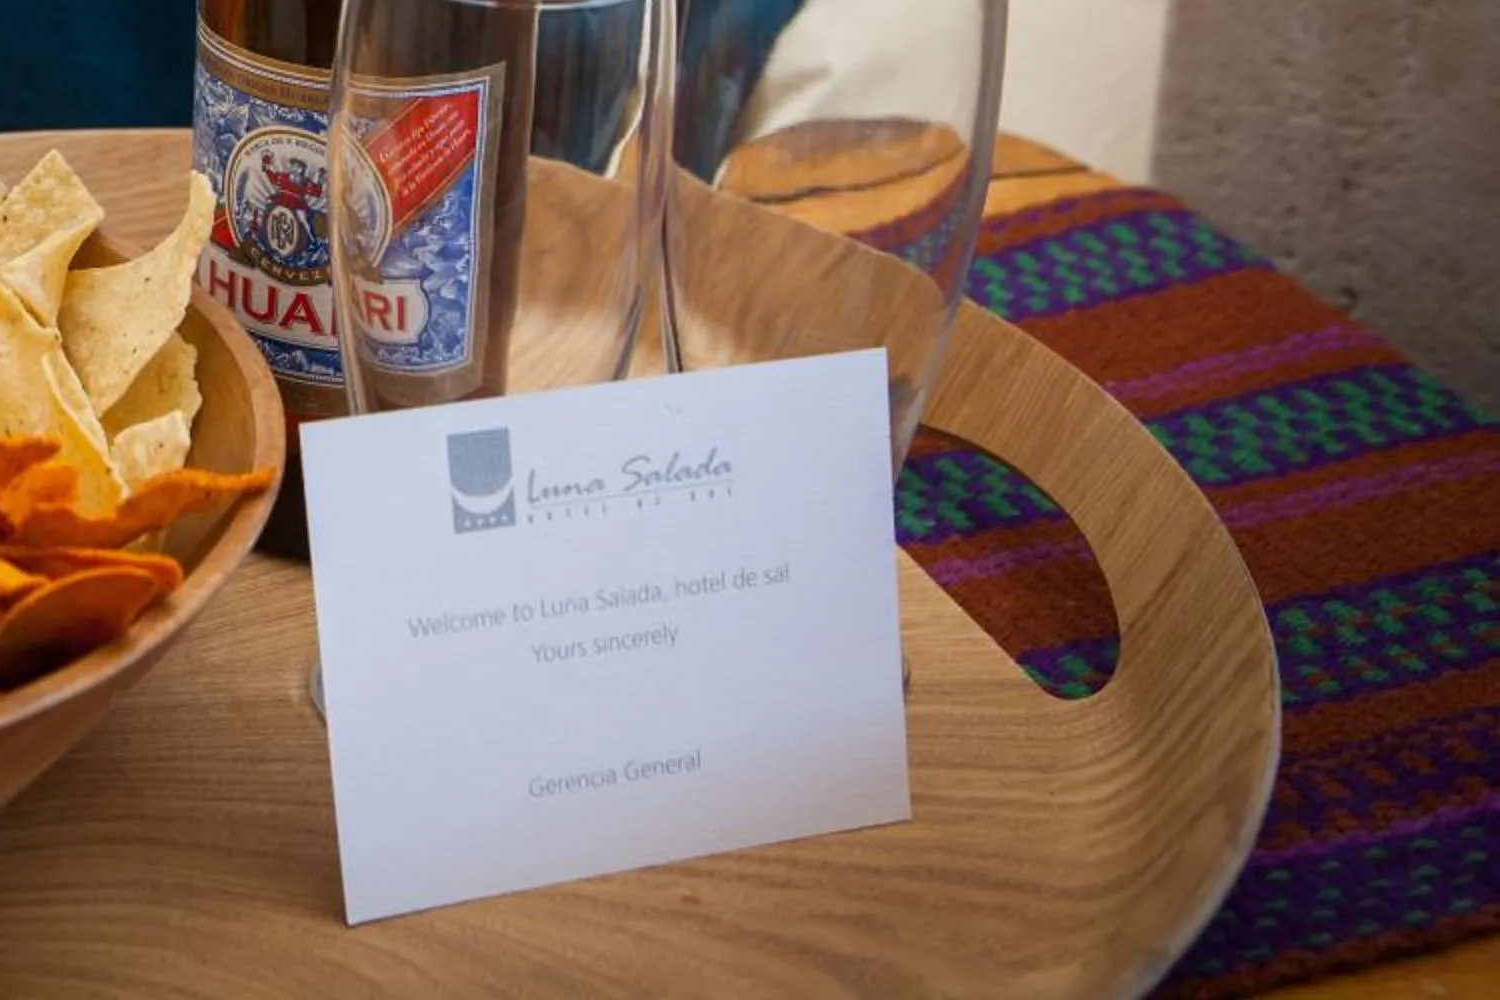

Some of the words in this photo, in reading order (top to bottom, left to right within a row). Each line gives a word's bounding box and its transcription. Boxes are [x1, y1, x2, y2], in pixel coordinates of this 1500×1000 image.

[527, 467, 606, 504] Luna
[620, 446, 733, 492] Salada
[407, 608, 506, 638] Welcome
[512, 602, 535, 624] to
[540, 597, 590, 619] Luna
[596, 582, 665, 612] Salada,
[674, 571, 728, 600] hotel
[732, 567, 758, 591] de
[762, 561, 790, 586] sal
[530, 642, 589, 665] Yours
[593, 621, 679, 656] sincerely
[527, 766, 618, 799] Gerencia
[623, 749, 702, 782] General
